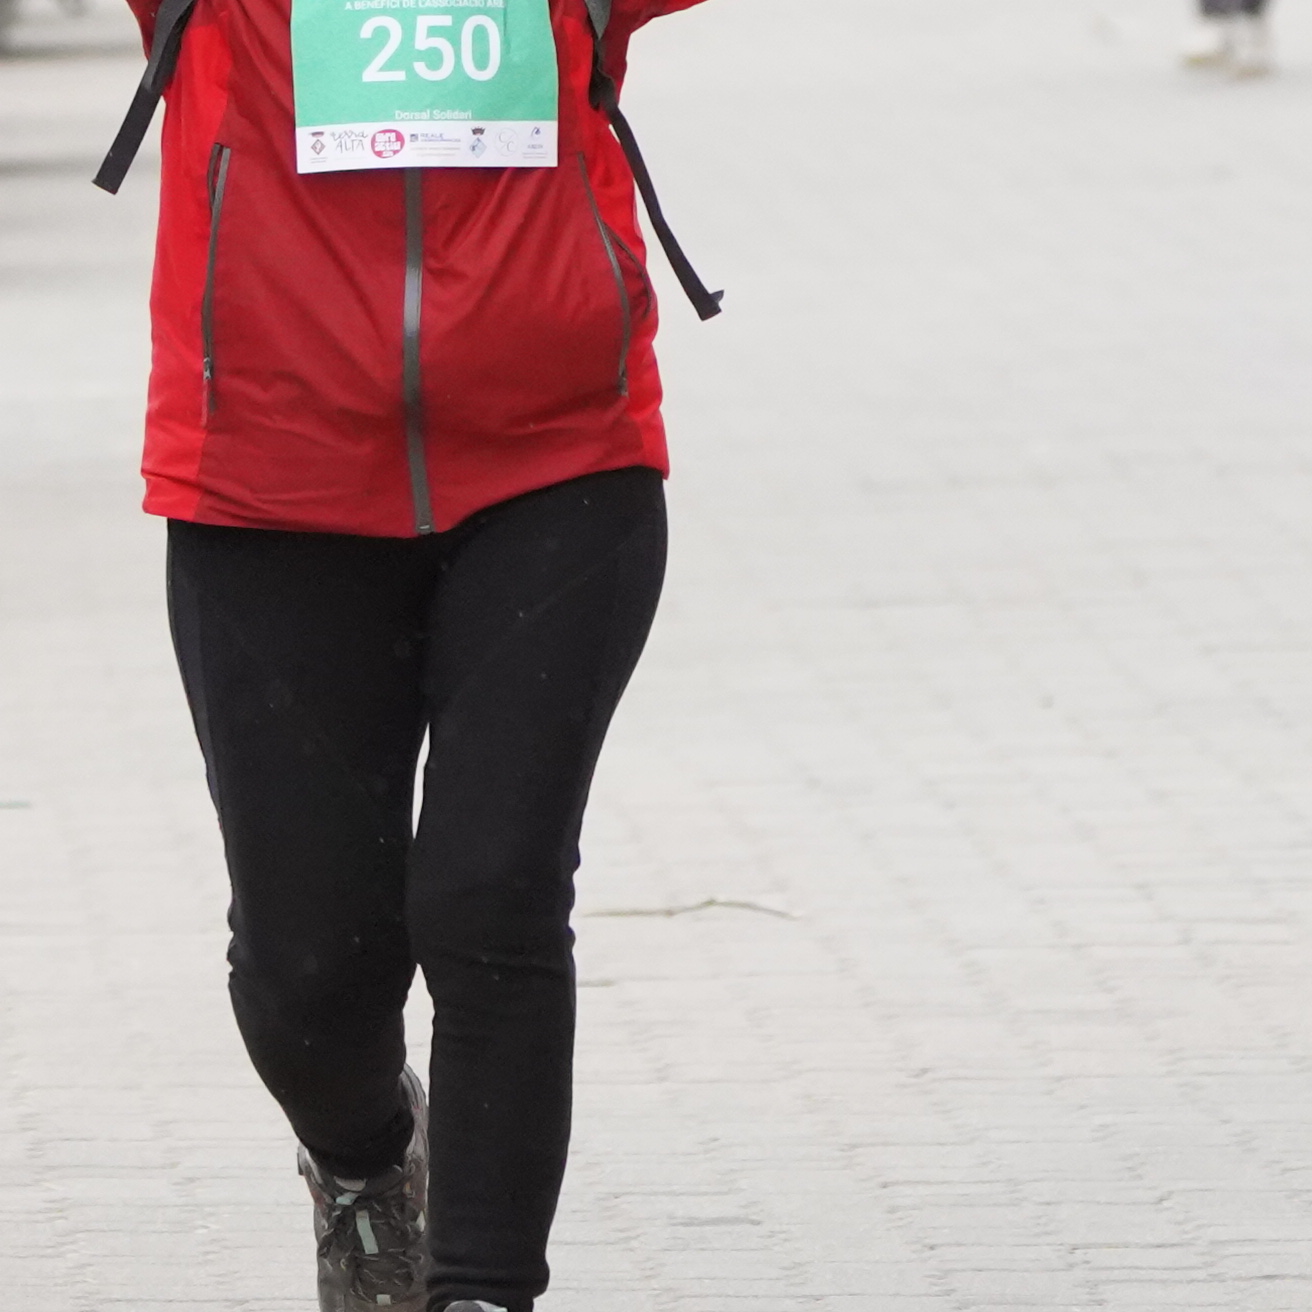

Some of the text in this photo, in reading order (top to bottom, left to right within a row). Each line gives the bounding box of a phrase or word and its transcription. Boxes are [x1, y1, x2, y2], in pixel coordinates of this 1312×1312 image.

[344, 0, 353, 10] A
[359, 14, 502, 83] 250
[395, 108, 472, 120] Dorsal Solidari
